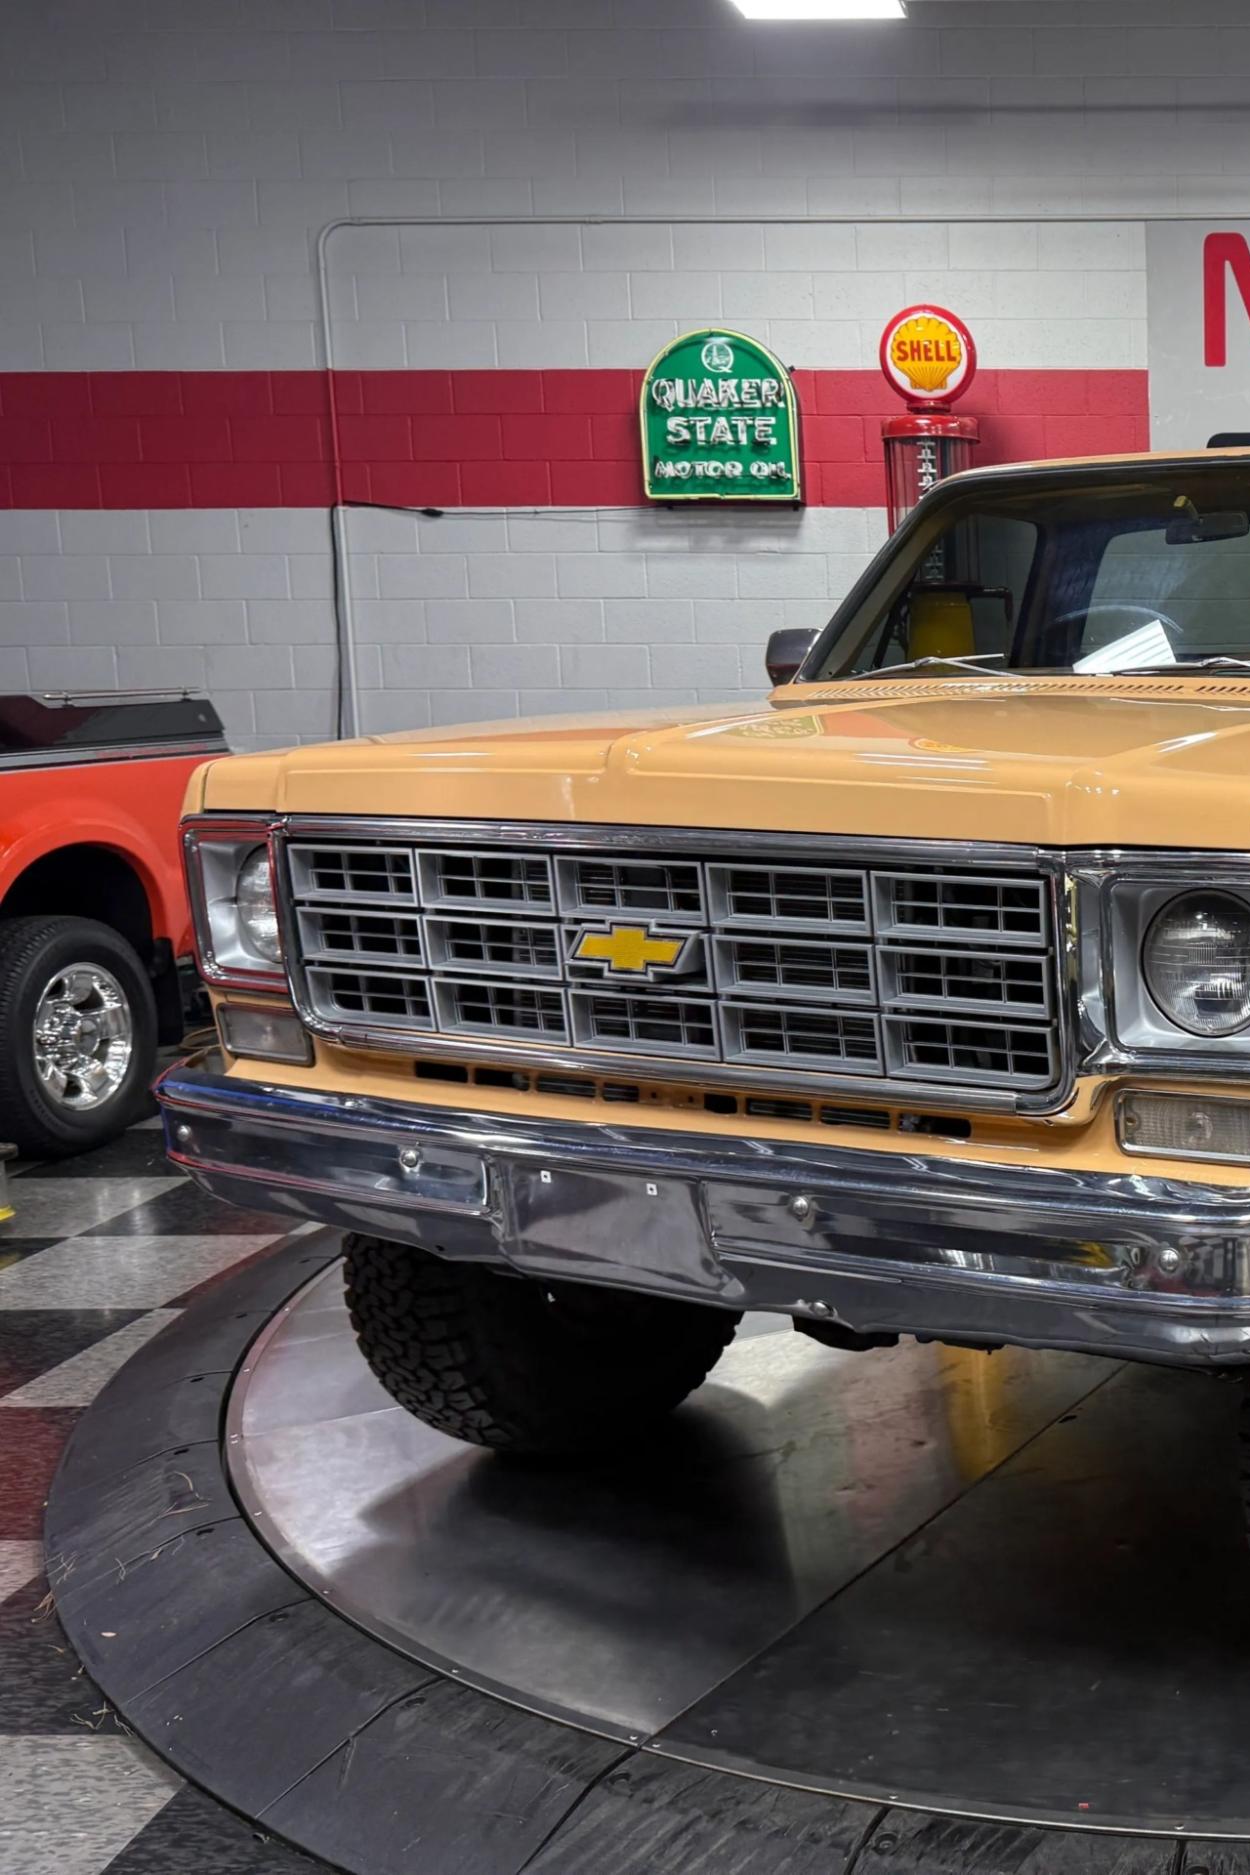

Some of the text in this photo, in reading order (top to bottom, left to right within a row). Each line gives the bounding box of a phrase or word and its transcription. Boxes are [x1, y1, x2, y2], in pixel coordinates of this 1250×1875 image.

[896, 340, 957, 361] SHELL
[652, 378, 785, 412] QUAKER
[666, 416, 777, 445] STATE
[655, 461, 791, 478] MOTOR OIL
